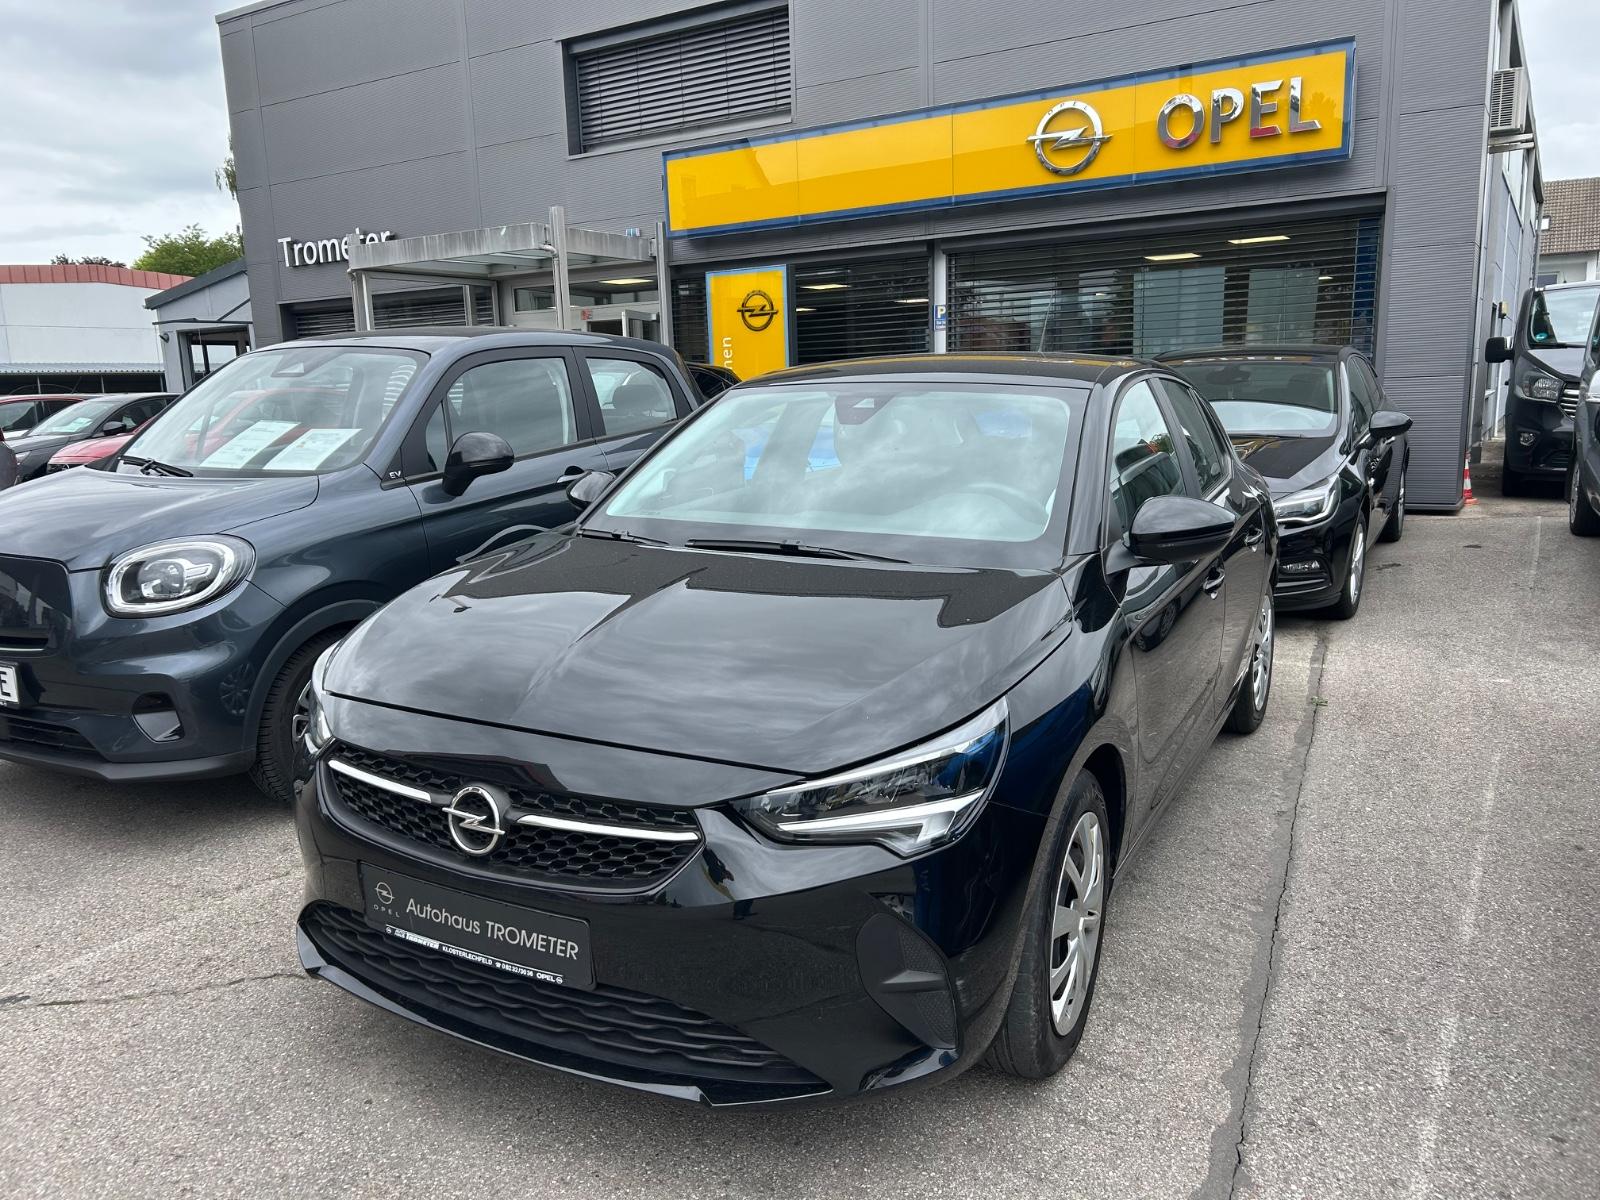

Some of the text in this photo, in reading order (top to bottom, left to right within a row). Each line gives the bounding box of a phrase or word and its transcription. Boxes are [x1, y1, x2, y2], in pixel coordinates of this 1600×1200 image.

[1157, 76, 1322, 149] OPEL
[937, 306, 946, 319] P
[389, 470, 402, 479] EV
[0, 671, 11, 698] E
[374, 904, 400, 918] OPEL
[406, 898, 579, 960] Autohaus TROMETER
[536, 972, 556, 983] OPEL
